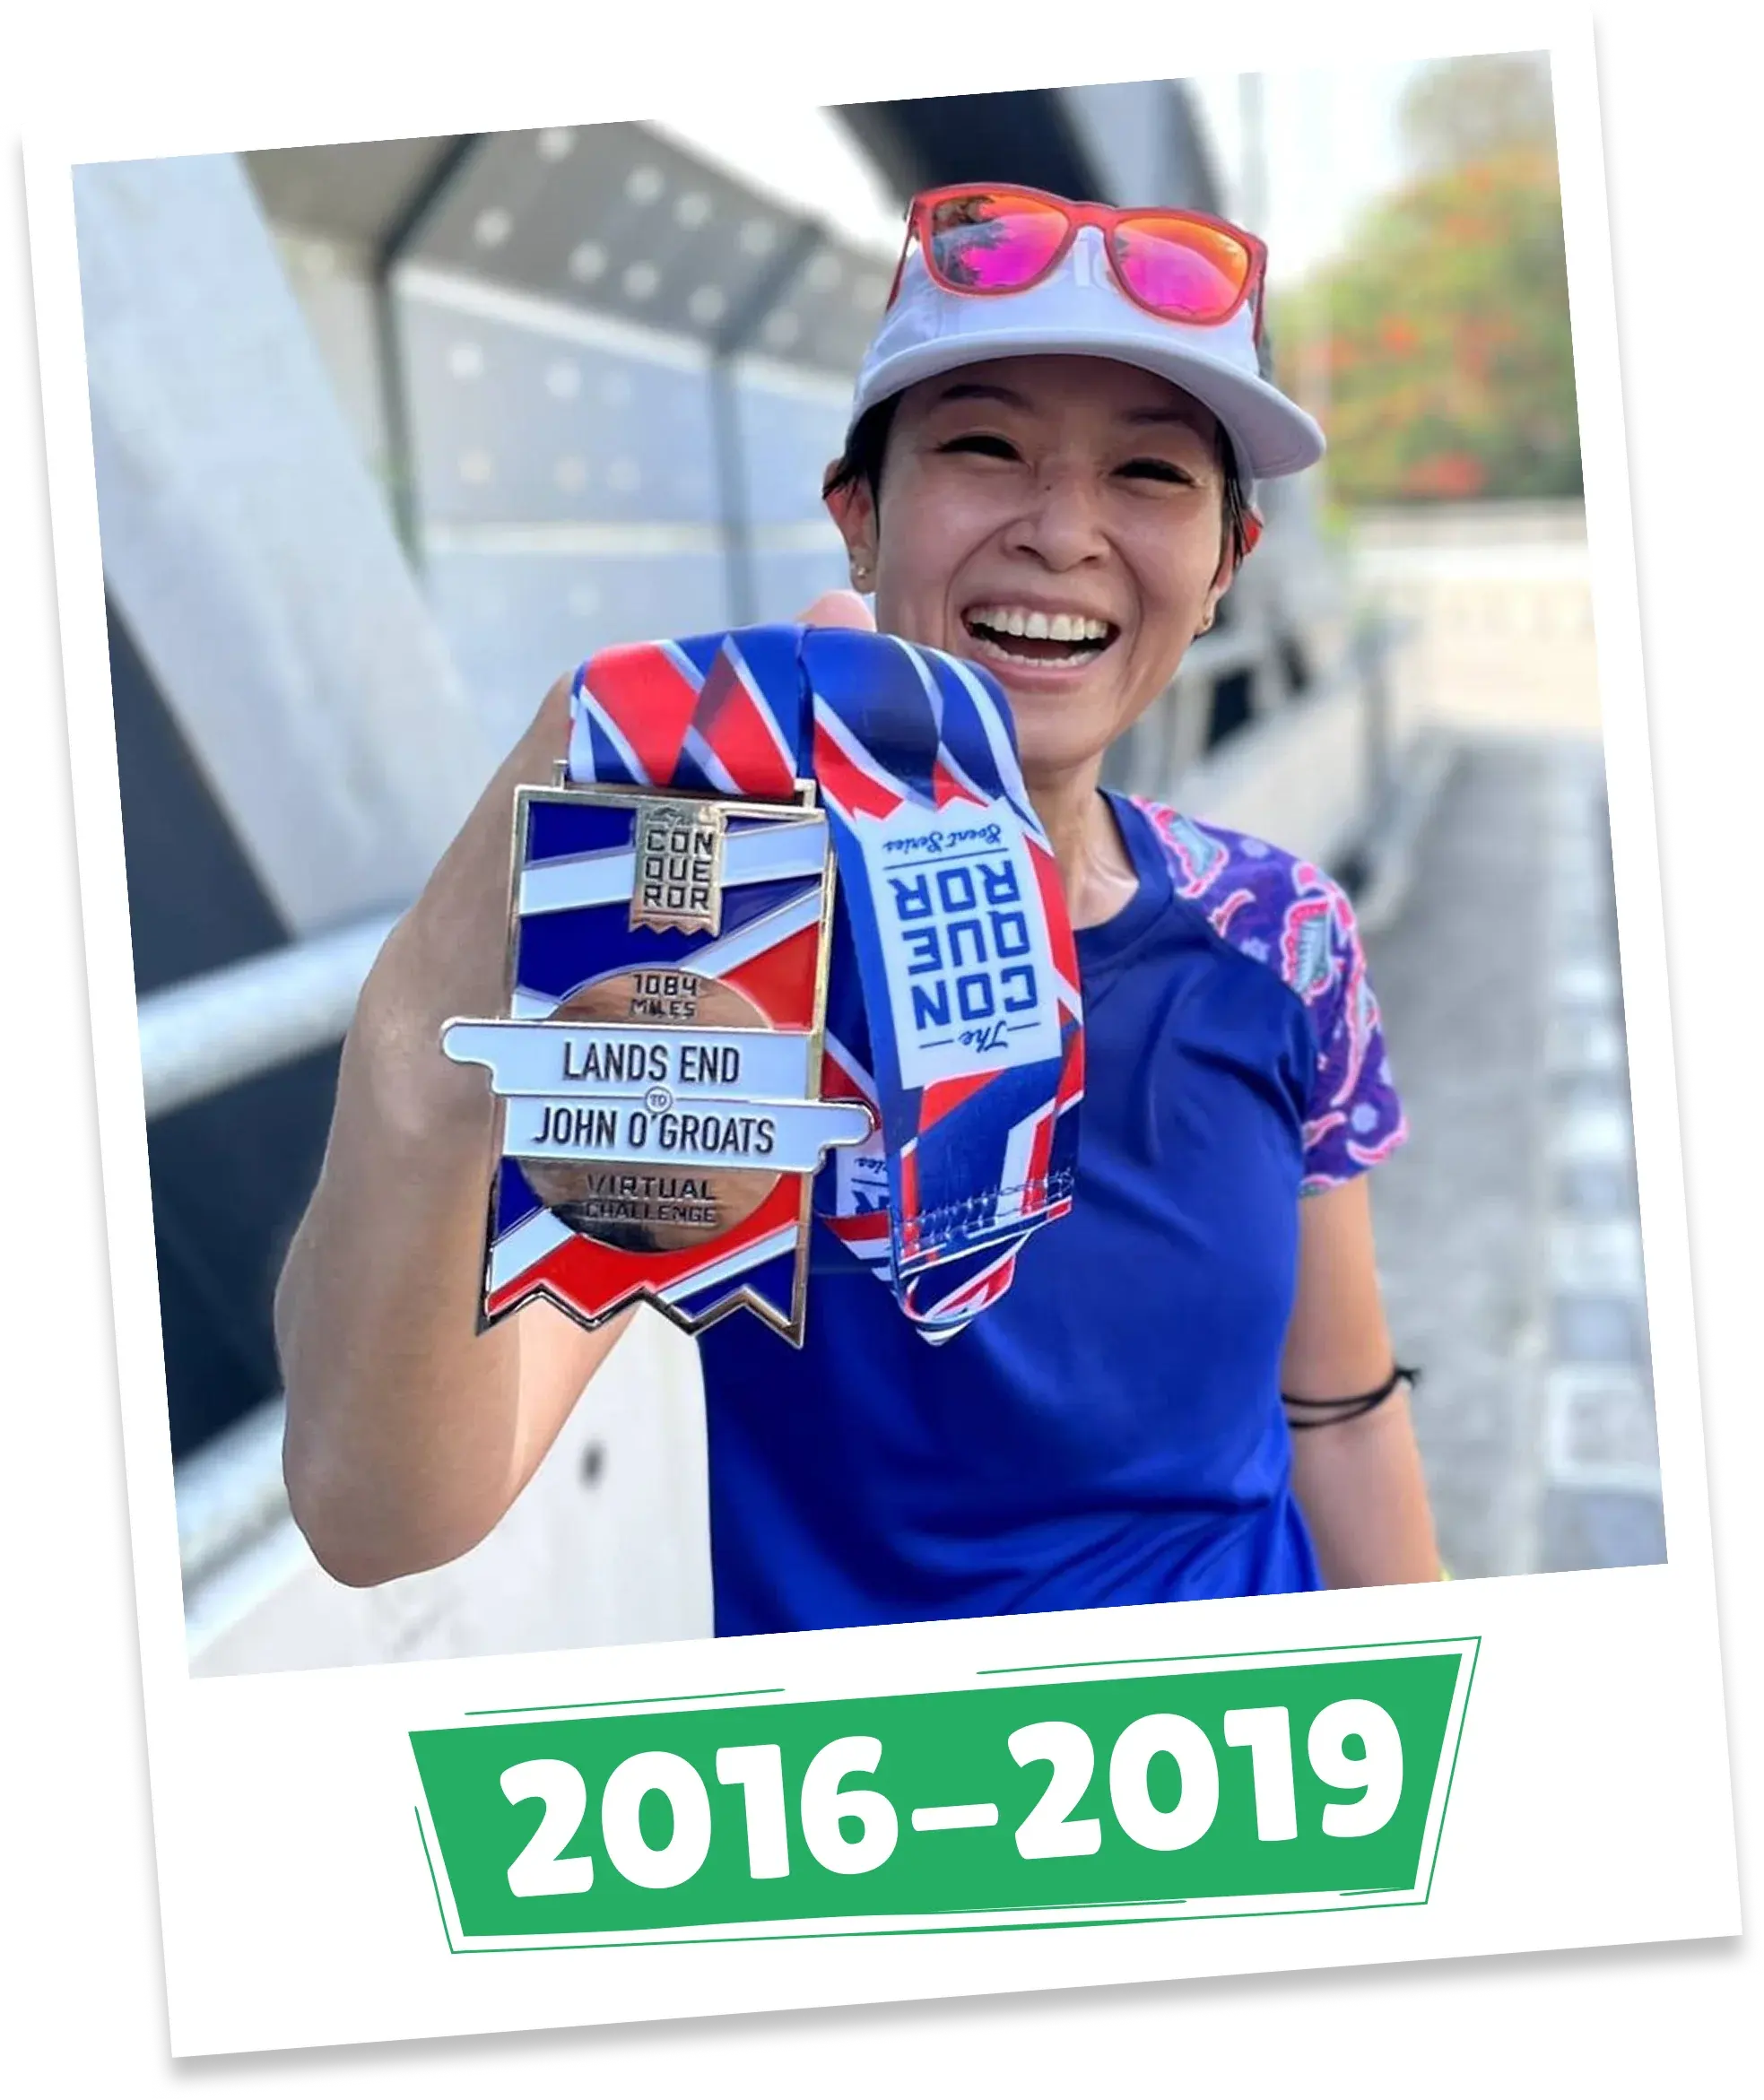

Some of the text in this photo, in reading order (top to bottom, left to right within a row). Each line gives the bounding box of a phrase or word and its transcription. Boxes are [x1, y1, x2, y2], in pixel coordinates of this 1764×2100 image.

[647, 829, 714, 855] CON
[882, 822, 1002, 855] Event Series
[645, 856, 712, 883] QUE
[642, 883, 709, 910] ROR
[887, 859, 1021, 922] ROR
[901, 910, 1031, 976] QUE
[632, 973, 697, 997] 1084
[911, 964, 1038, 1031] CON
[630, 998, 697, 1017] MILES
[959, 1020, 1008, 1054] The
[562, 1040, 740, 1083] LANDS END
[649, 1094, 666, 1108] TO
[532, 1106, 776, 1155] JOHN O'GROATS
[587, 1174, 717, 1201] VIRTUAL
[584, 1199, 717, 1222] CHALLENGE
